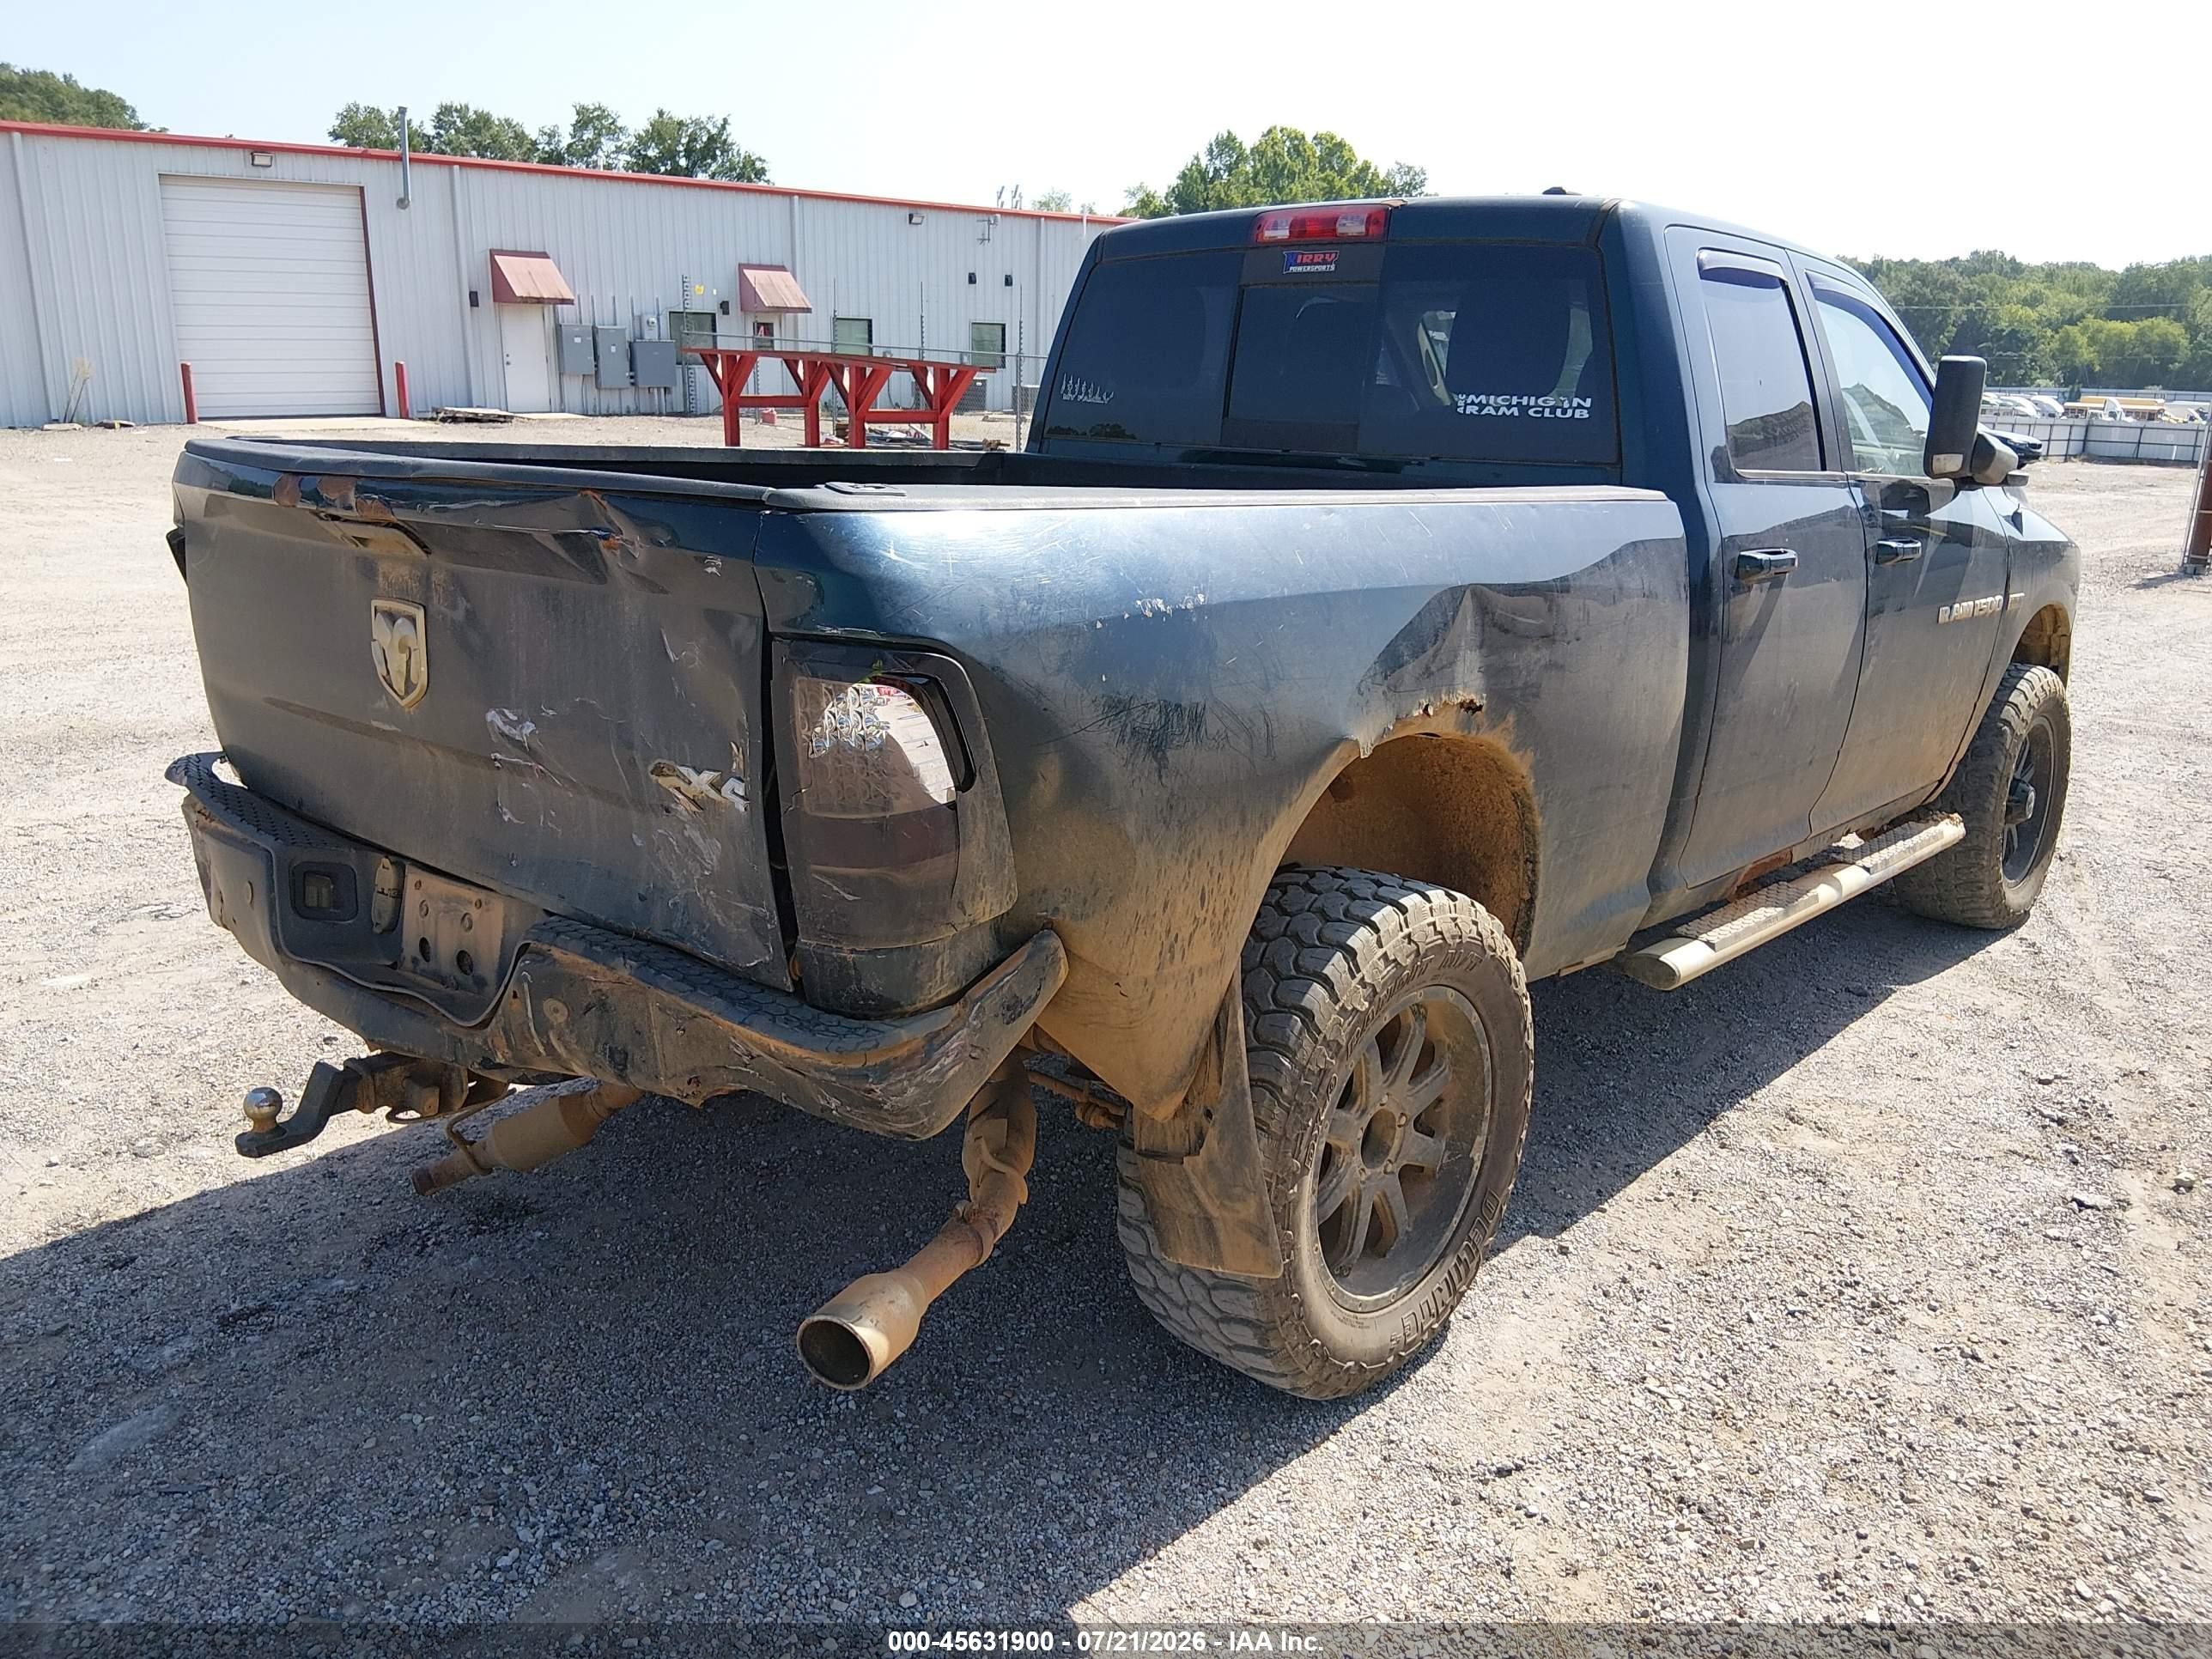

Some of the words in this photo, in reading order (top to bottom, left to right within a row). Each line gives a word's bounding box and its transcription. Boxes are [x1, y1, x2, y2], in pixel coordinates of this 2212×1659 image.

[1289, 264, 1335, 273] POWERSPORTS
[1465, 405, 1519, 416] RAM
[1528, 407, 1589, 418] CLUB
[1938, 601, 1973, 624] RAM
[1974, 594, 2003, 617] 1500
